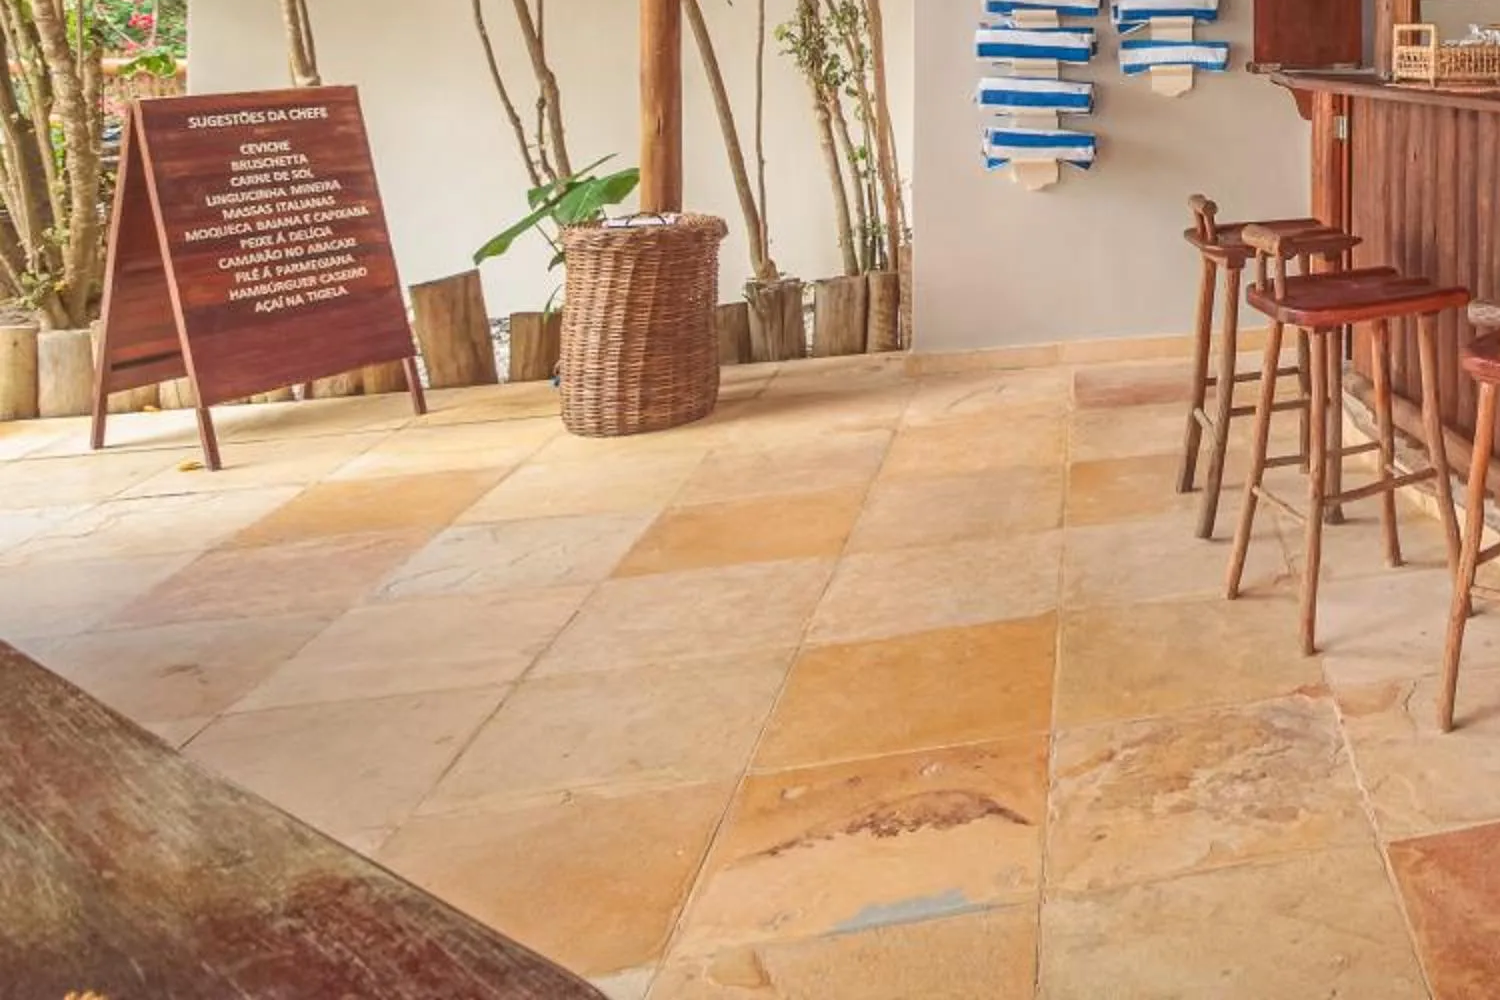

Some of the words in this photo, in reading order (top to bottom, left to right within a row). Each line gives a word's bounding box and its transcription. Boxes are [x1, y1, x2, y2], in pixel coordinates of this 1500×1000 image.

[188, 111, 266, 129] SUGESTÕES
[267, 110, 289, 122] DA
[288, 107, 329, 120] CHEFE
[239, 140, 292, 155] CEVICHE
[230, 153, 309, 172] BRUSCHETTA
[230, 173, 272, 187] CARNE
[273, 171, 290, 182] DE
[291, 168, 315, 180] SOL
[291, 179, 342, 196] MINEIRA
[222, 206, 274, 221] MASSAS
[275, 196, 336, 212] ITALIANAS
[184, 223, 253, 243] MOQUECA
[256, 214, 303, 231] BAIANA
[303, 213, 312, 223] E
[313, 205, 370, 223] CAPIXABA
[240, 234, 275, 250] PEIXE
[289, 225, 334, 241] DELÍCIA
[218, 249, 283, 270] CAMARÃO
[284, 246, 305, 258] NO
[307, 237, 358, 255] ABACAXI
[235, 268, 262, 284] FILÉ
[275, 253, 356, 277] PARMEGIANA
[319, 267, 368, 285] CASEIRO
[255, 299, 286, 314] AÇAÍ
[285, 294, 306, 307] NA
[305, 285, 350, 302] TIGELA
